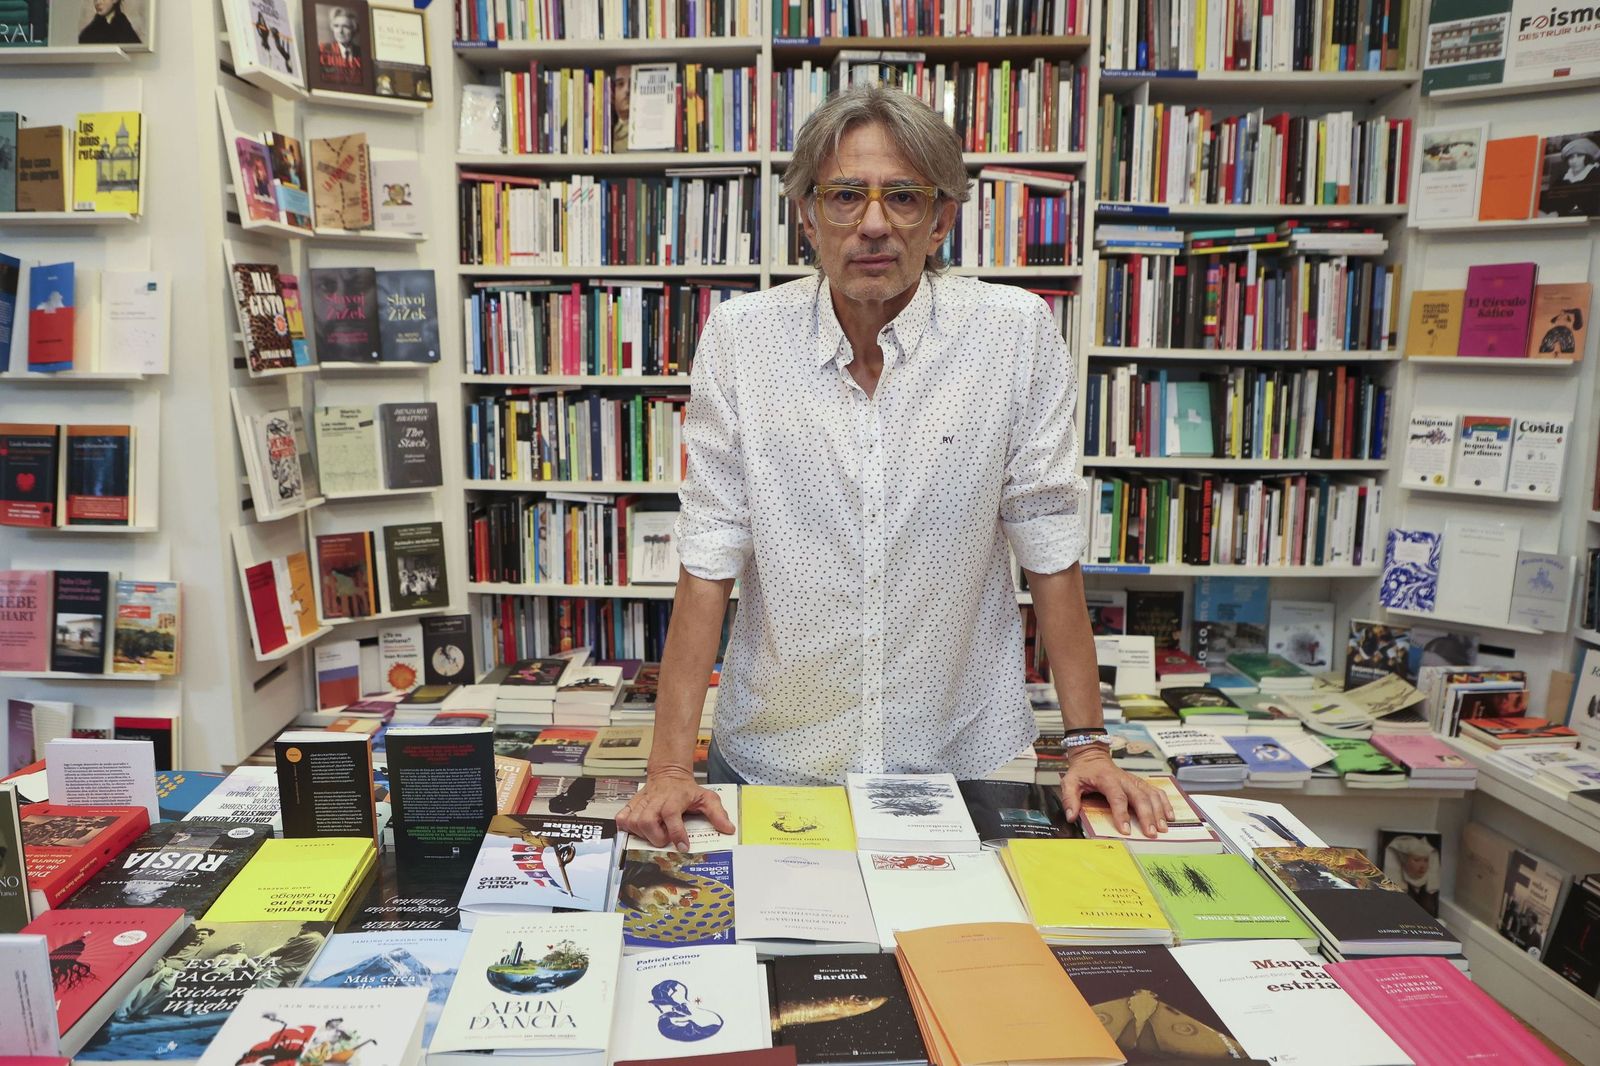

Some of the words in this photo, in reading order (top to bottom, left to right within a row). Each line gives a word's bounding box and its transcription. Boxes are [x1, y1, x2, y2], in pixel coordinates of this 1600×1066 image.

[79, 120, 94, 134] Los
[250, 272, 276, 293] MAL
[1520, 421, 1564, 434] Cosita
[542, 822, 603, 830] CUMBRE
[530, 831, 602, 839] BANDERA
[122, 852, 228, 872] RUSIA
[361, 921, 444, 929] THACKER
[186, 956, 277, 969] ESPAÑA
[636, 956, 670, 966] Patricia
[636, 963, 656, 972] Caer
[668, 959, 691, 967] cielo
[1250, 959, 1321, 970] Mapa
[172, 971, 273, 982] PAGANA
[344, 973, 376, 984] Más
[378, 975, 416, 983] cerca
[813, 973, 868, 981] Sardiña
[1300, 969, 1331, 979] da
[165, 983, 255, 998] Richard
[1266, 978, 1342, 992] estría
[163, 999, 239, 1015] Wright
[468, 1015, 577, 1030] DANCIA
